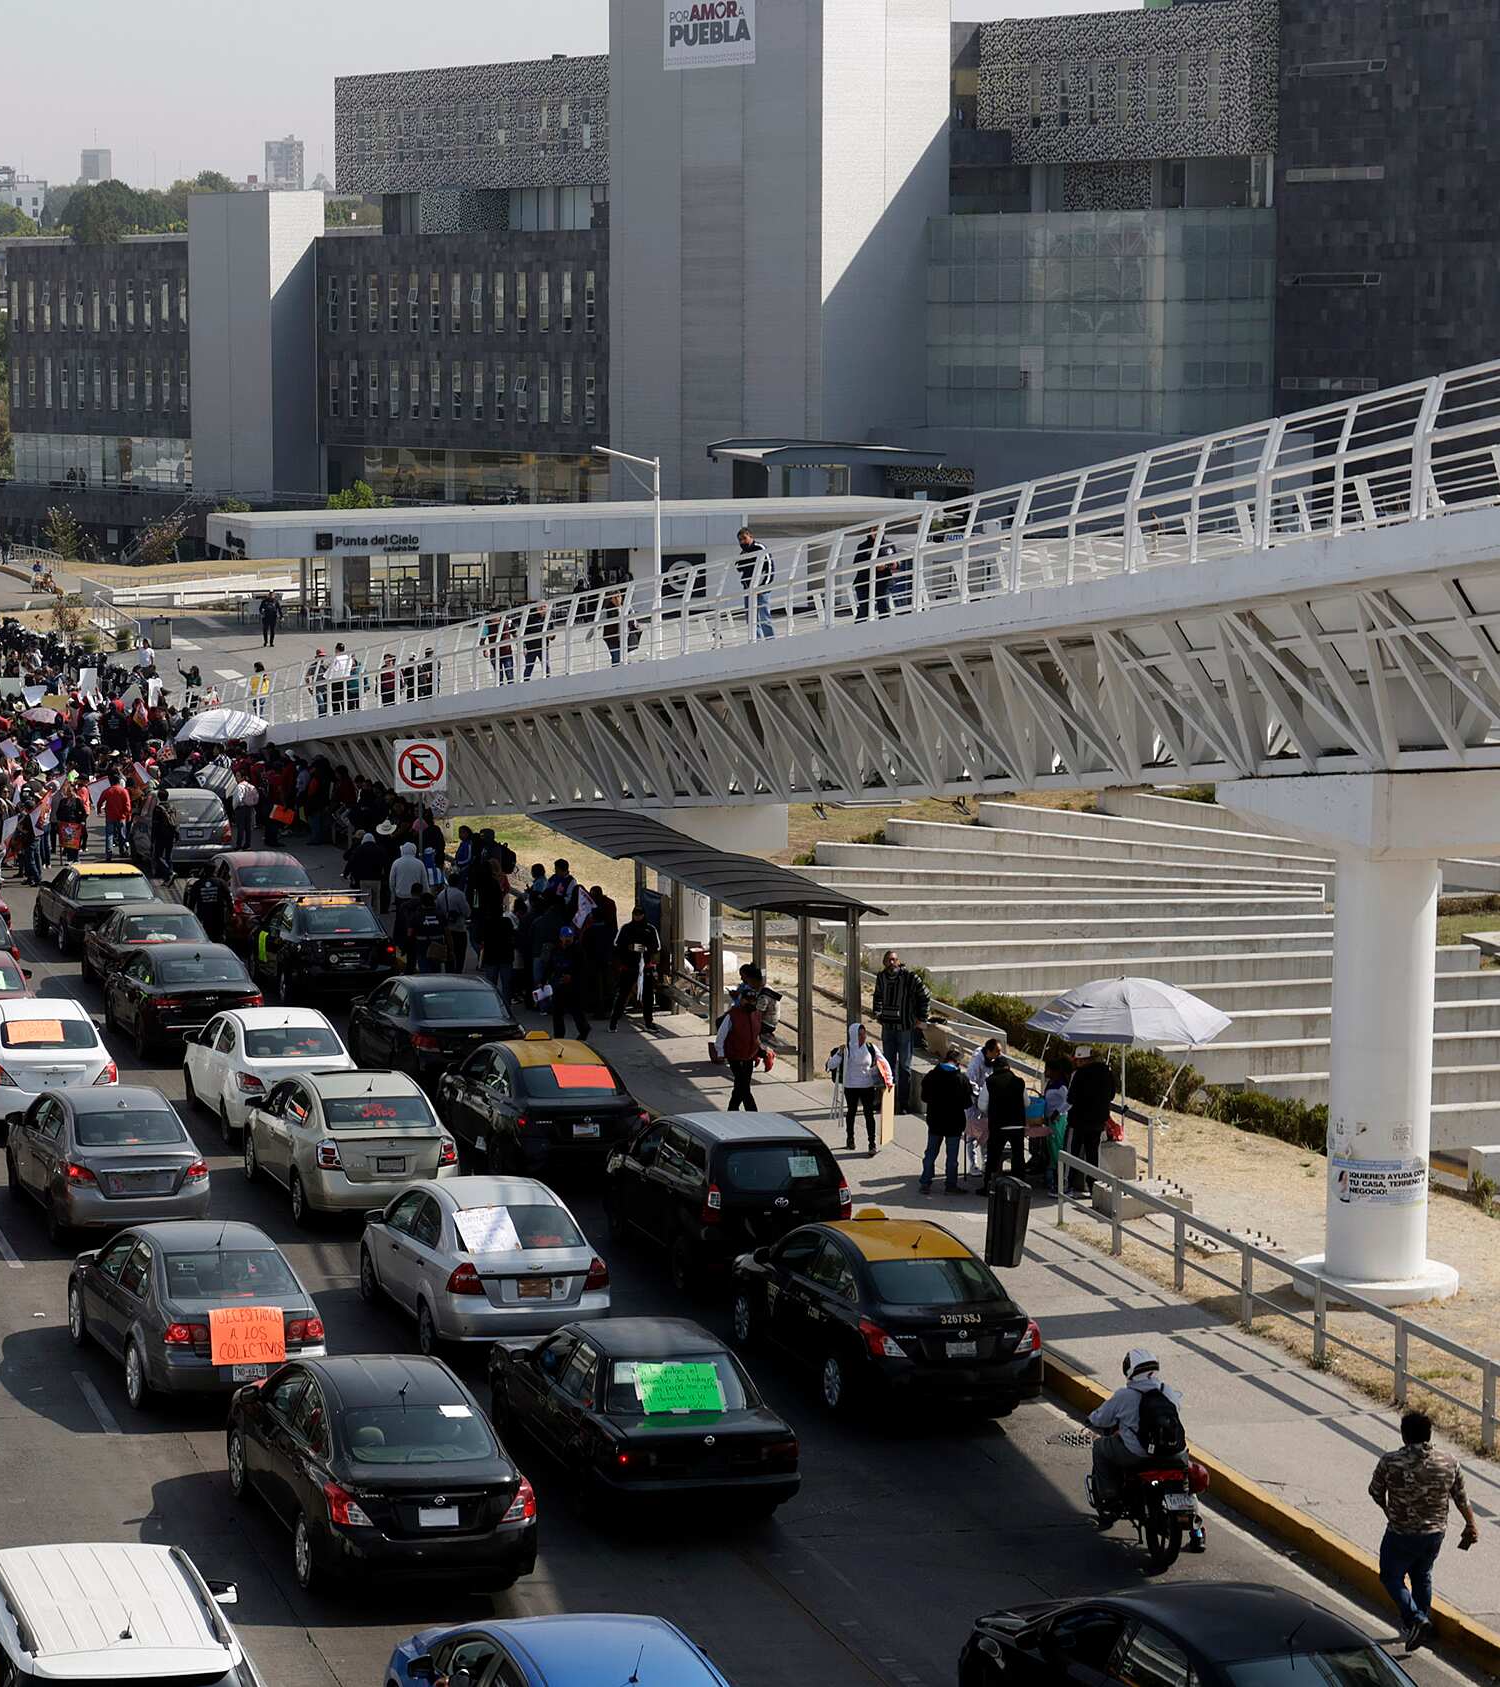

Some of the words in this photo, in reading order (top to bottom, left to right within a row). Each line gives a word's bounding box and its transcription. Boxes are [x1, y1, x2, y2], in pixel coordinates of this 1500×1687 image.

[669, 10, 689, 23] POR
[690, 1, 739, 21] AMOR
[669, 18, 751, 47] PUEBLA
[335, 535, 368, 546] Punta
[371, 534, 388, 545] del
[390, 533, 419, 545] Cielo
[1387, 1171, 1413, 1180] AYUDA
[1349, 1179, 1359, 1187] TU
[1388, 1178, 1421, 1188] TERRENO
[229, 1327, 239, 1340] A
[244, 1326, 268, 1341] LOS
